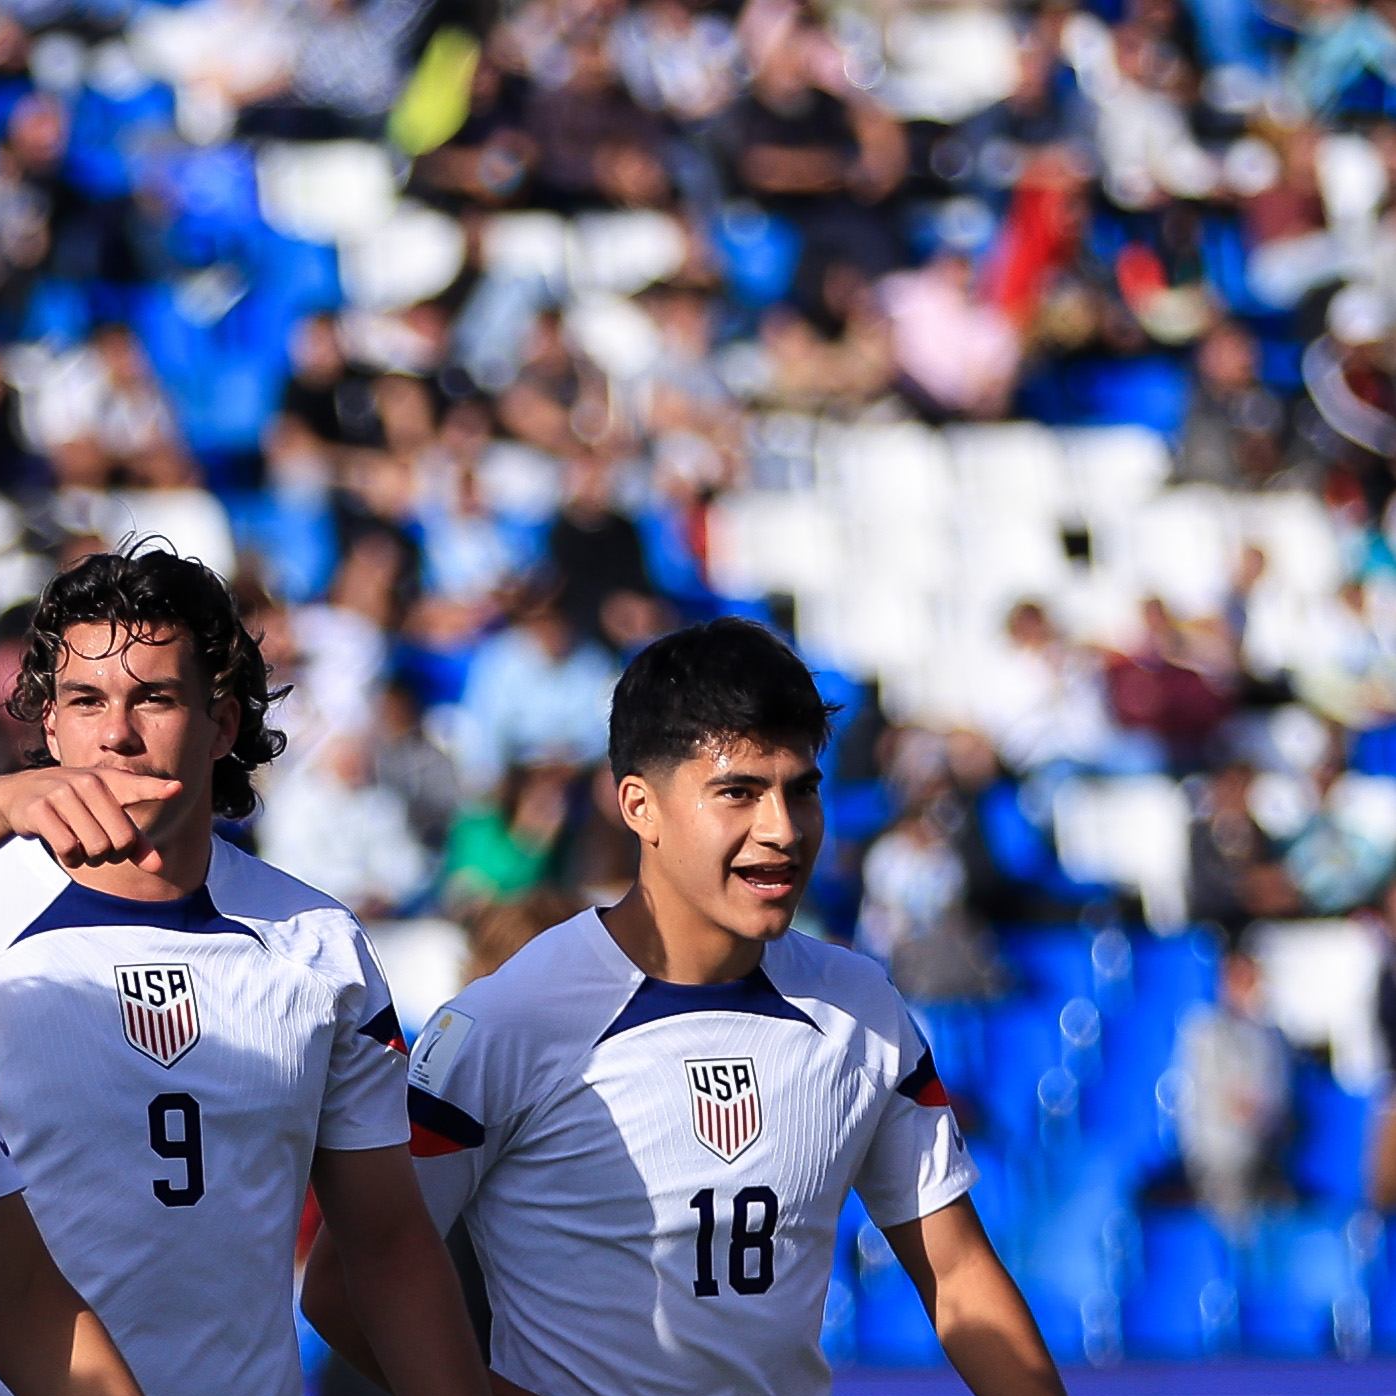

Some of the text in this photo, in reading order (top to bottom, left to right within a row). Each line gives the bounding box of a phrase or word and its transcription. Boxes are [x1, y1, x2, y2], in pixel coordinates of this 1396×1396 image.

[121, 969, 187, 1007] USA
[691, 1064, 751, 1101] USA
[148, 1092, 205, 1207] 9
[690, 1186, 779, 1297] 18
